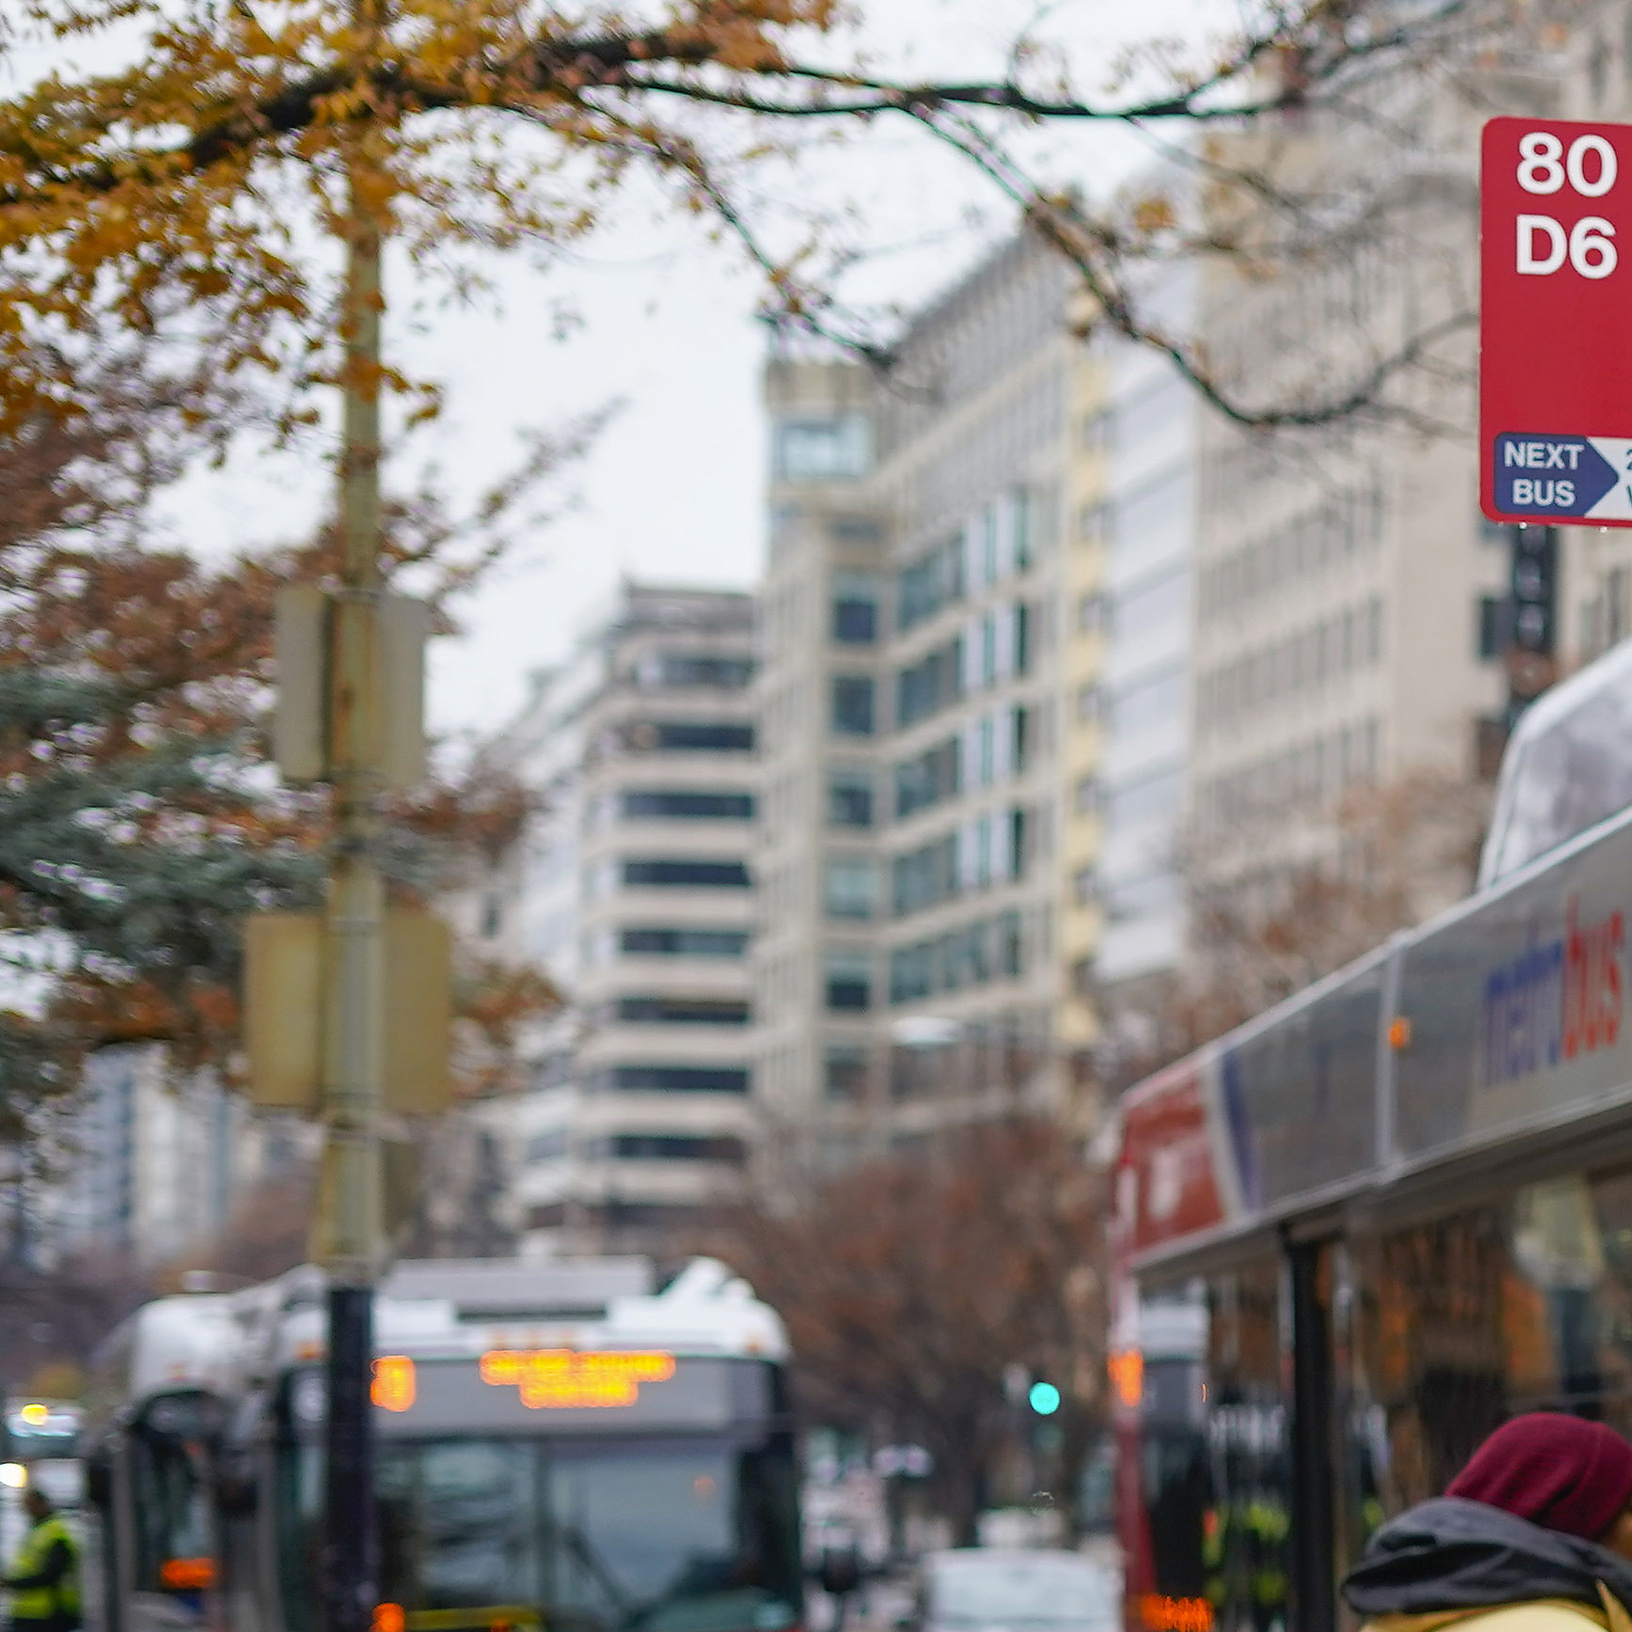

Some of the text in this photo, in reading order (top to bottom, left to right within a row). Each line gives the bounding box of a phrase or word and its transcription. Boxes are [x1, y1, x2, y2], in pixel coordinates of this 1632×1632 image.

[1516, 131, 1618, 198] 80
[1515, 214, 1618, 280] D6
[1503, 440, 1585, 471] NEXT
[1511, 478, 1576, 508] BUS
